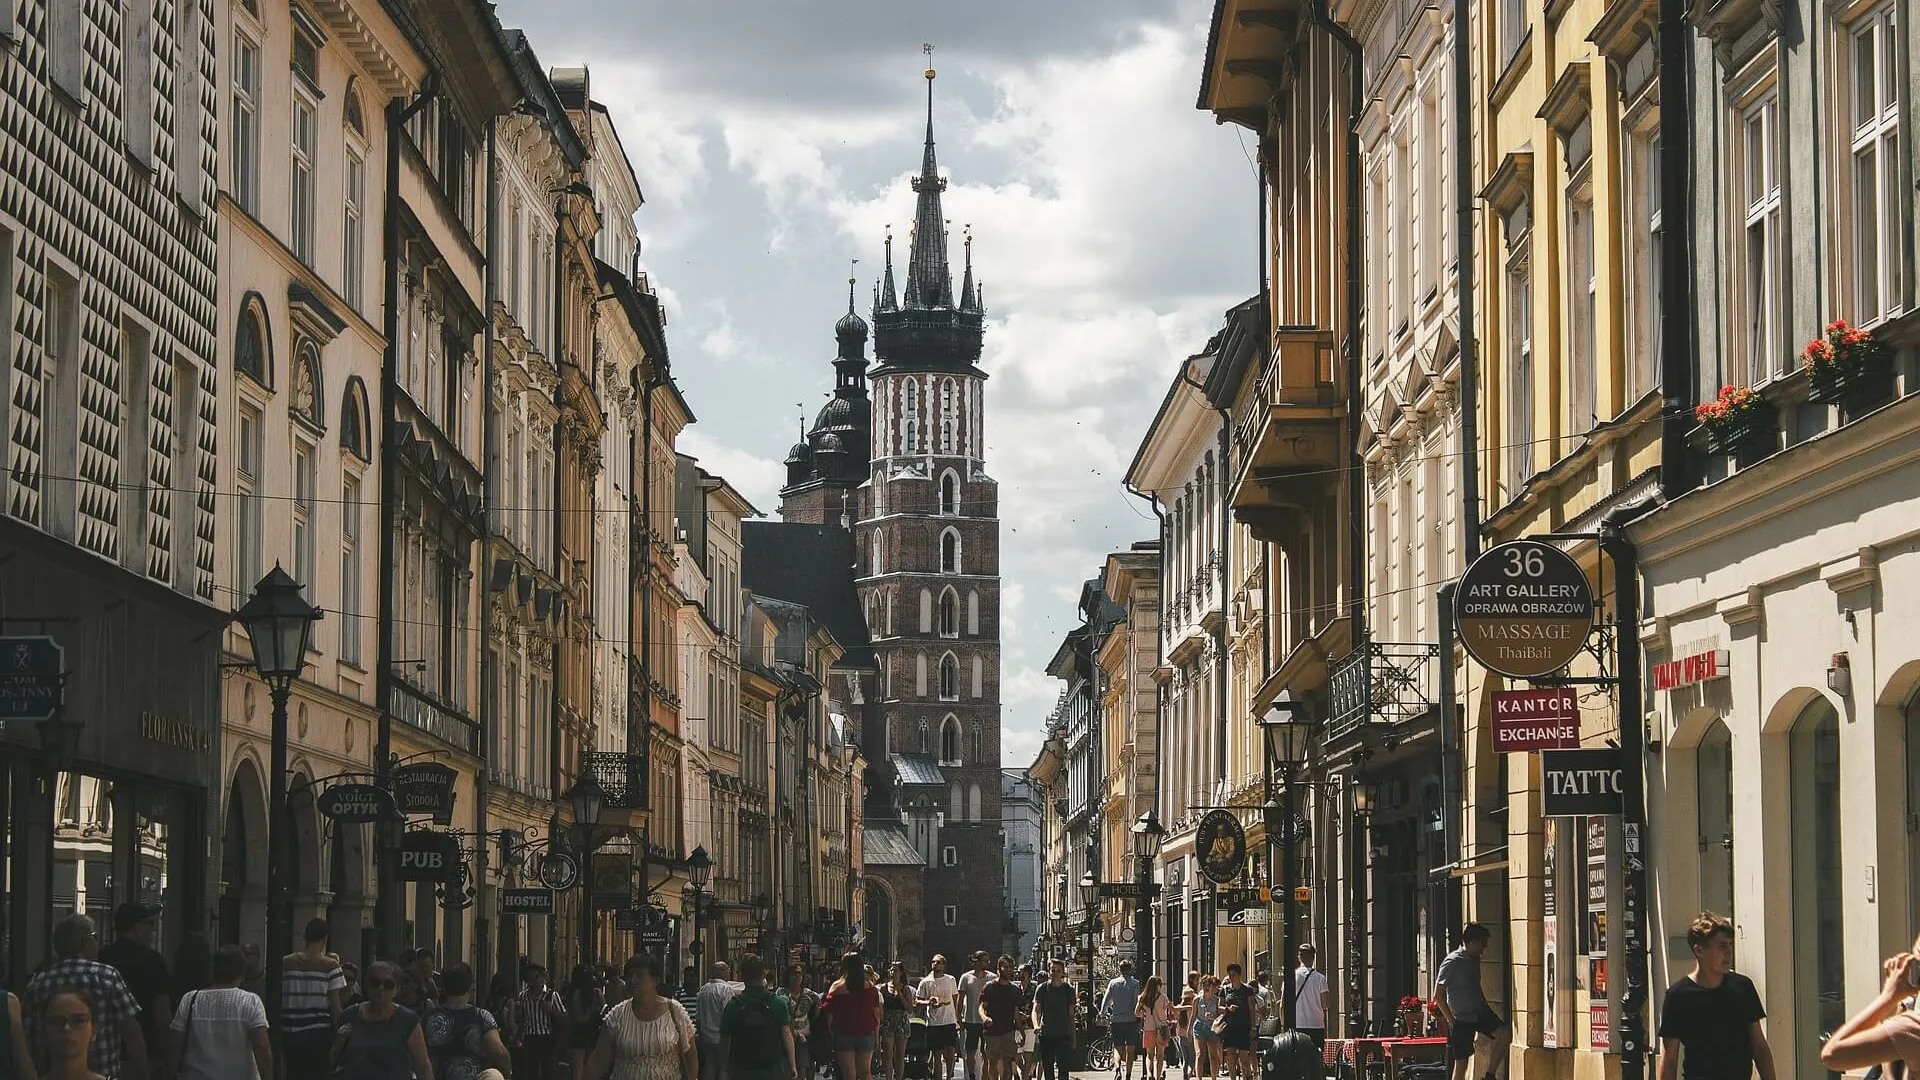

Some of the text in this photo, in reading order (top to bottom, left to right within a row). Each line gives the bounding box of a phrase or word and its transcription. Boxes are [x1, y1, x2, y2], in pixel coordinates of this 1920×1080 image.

[1503, 547, 1545, 577] 36
[1469, 584, 1581, 597] ART GALLERY
[1465, 600, 1585, 613] OPRAWA OBRAZÓW
[1478, 624, 1571, 640] MASSAGE
[1496, 646, 1552, 659] ThaiBali
[1498, 698, 1573, 713] KANTOR
[1500, 727, 1574, 742] EXCHANGE
[332, 802, 379, 815] OPTYK
[401, 851, 443, 868] PUB
[1111, 884, 1142, 897] HOTEL
[505, 895, 550, 907] HOSTEL
